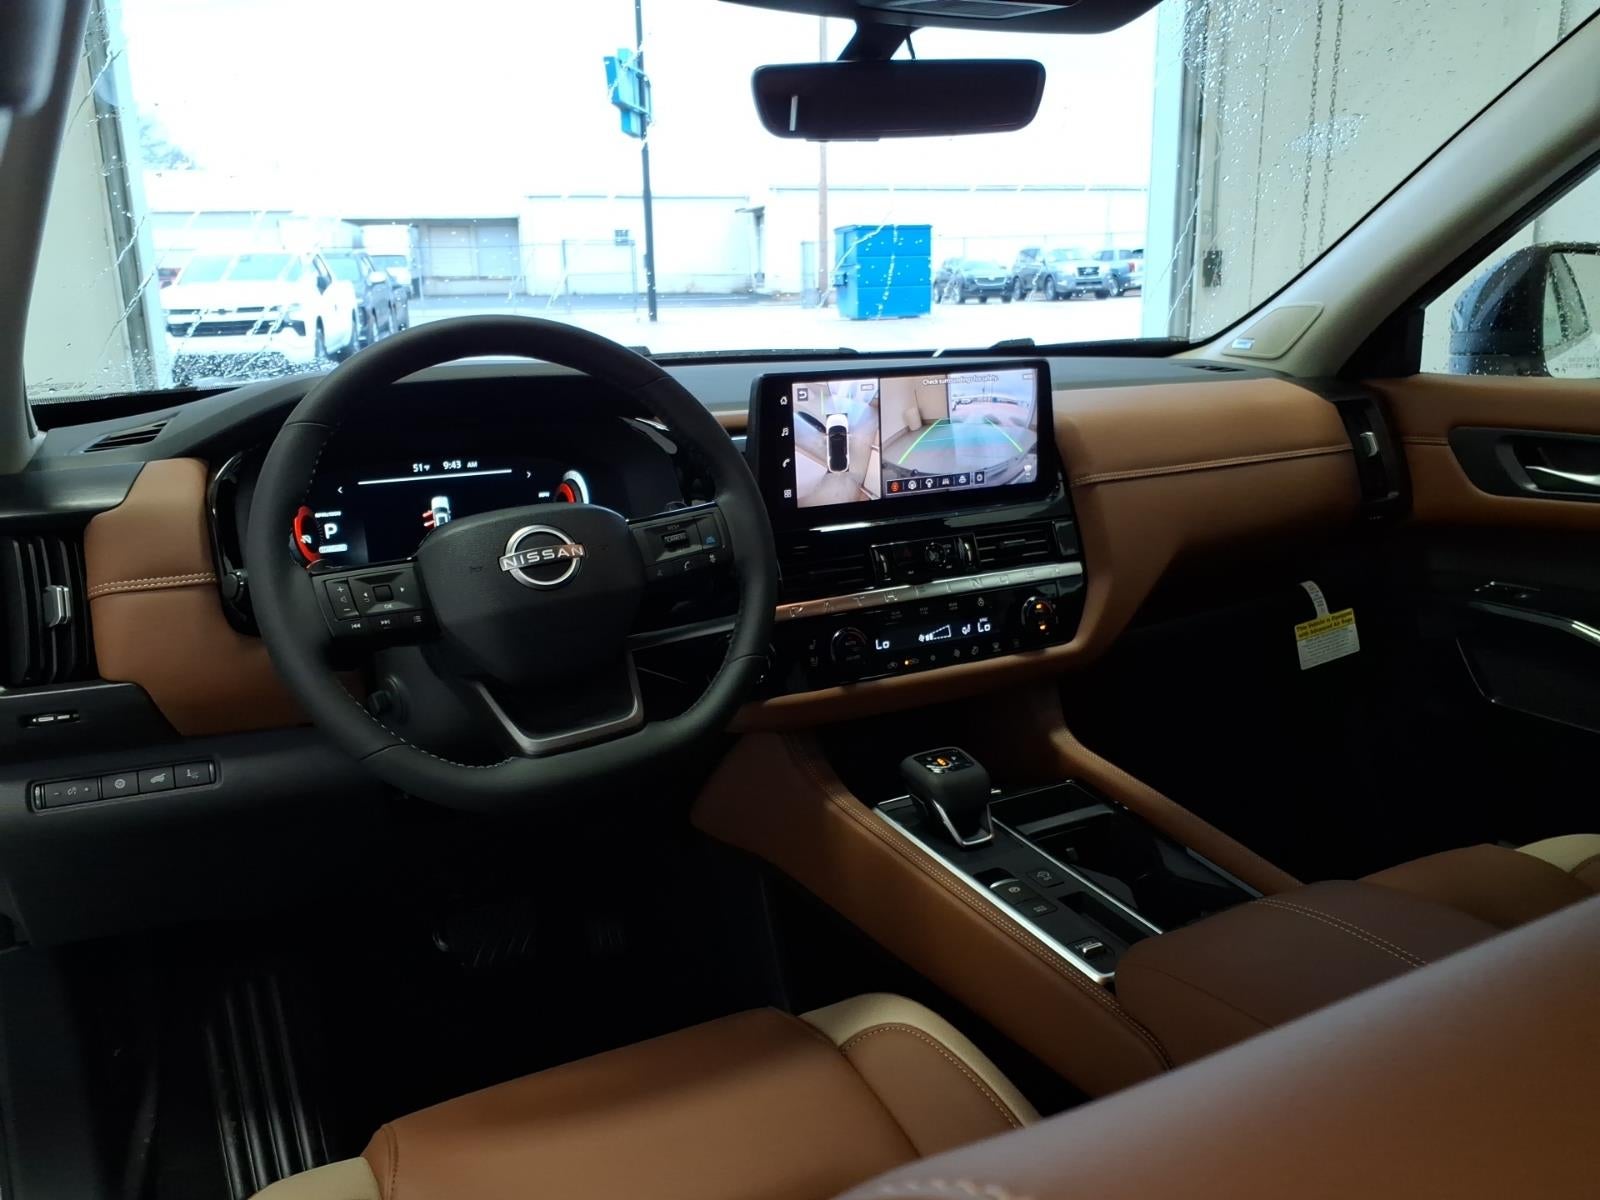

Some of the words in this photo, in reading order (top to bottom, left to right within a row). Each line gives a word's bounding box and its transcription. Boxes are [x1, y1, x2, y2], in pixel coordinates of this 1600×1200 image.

[442, 460, 461, 470] 9:43
[324, 523, 338, 539] P
[502, 546, 584, 569] NISSAN
[875, 639, 890, 650] Lo
